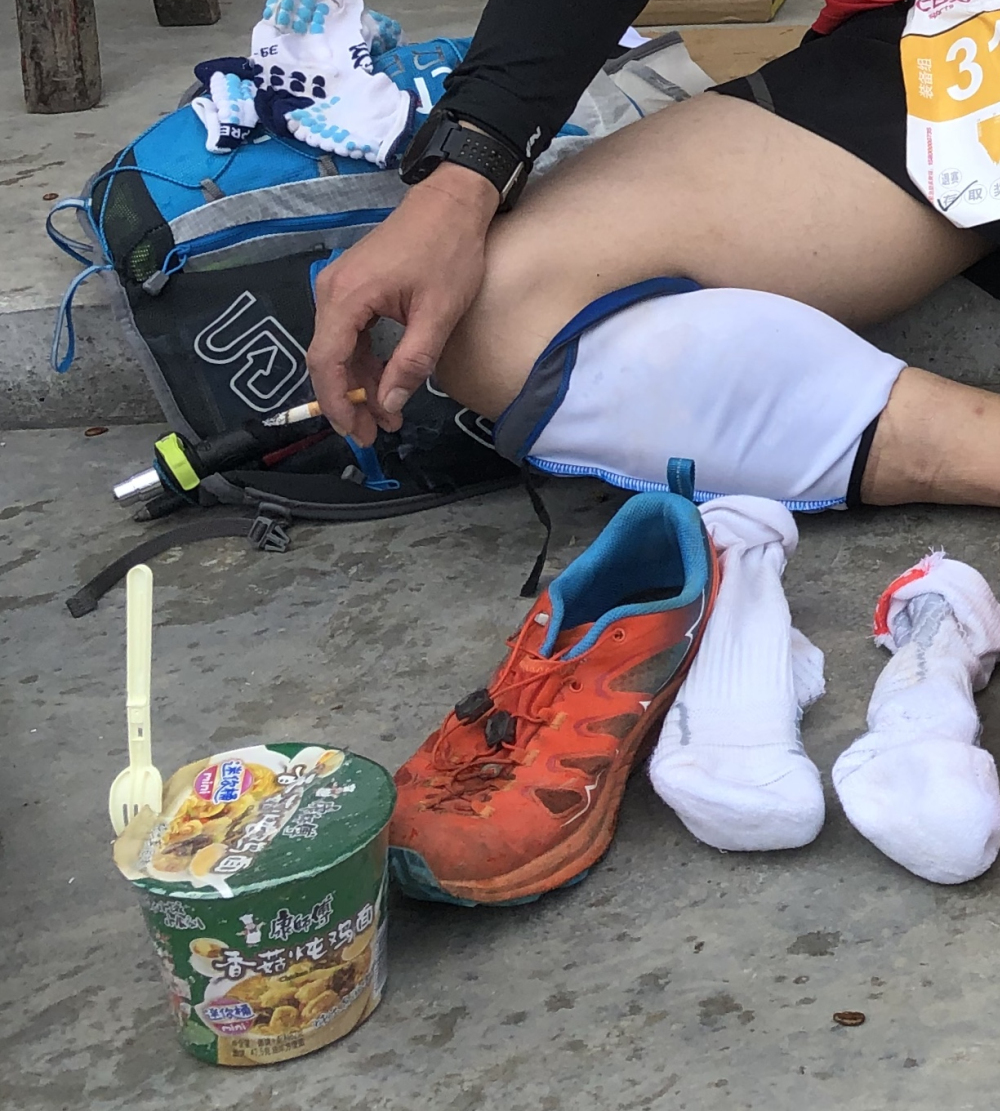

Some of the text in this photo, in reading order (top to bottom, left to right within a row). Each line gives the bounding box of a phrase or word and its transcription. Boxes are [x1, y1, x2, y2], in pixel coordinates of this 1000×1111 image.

[917, 57, 934, 99] 装备组
[199, 772, 213, 795] mini
[214, 903, 375, 979] 香菇炖鸡面
[221, 1022, 247, 1032] mini
